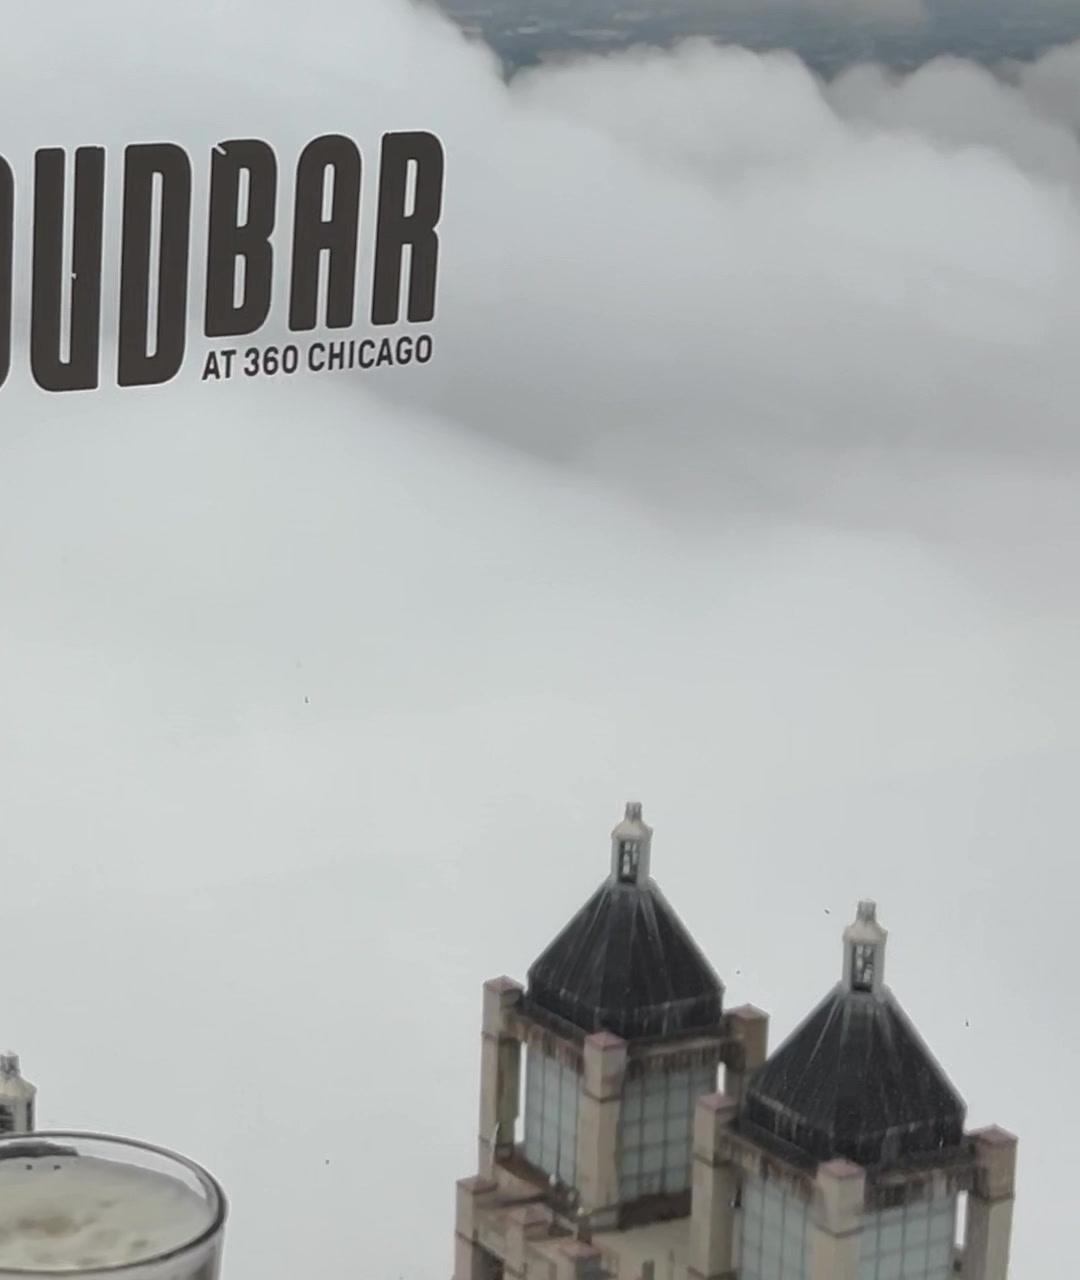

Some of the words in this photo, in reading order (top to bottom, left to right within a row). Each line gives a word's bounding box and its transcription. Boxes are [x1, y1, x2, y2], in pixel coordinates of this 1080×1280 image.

[201, 349, 237, 380] AT
[243, 345, 298, 377] 360
[307, 334, 433, 371] CHICAGO
